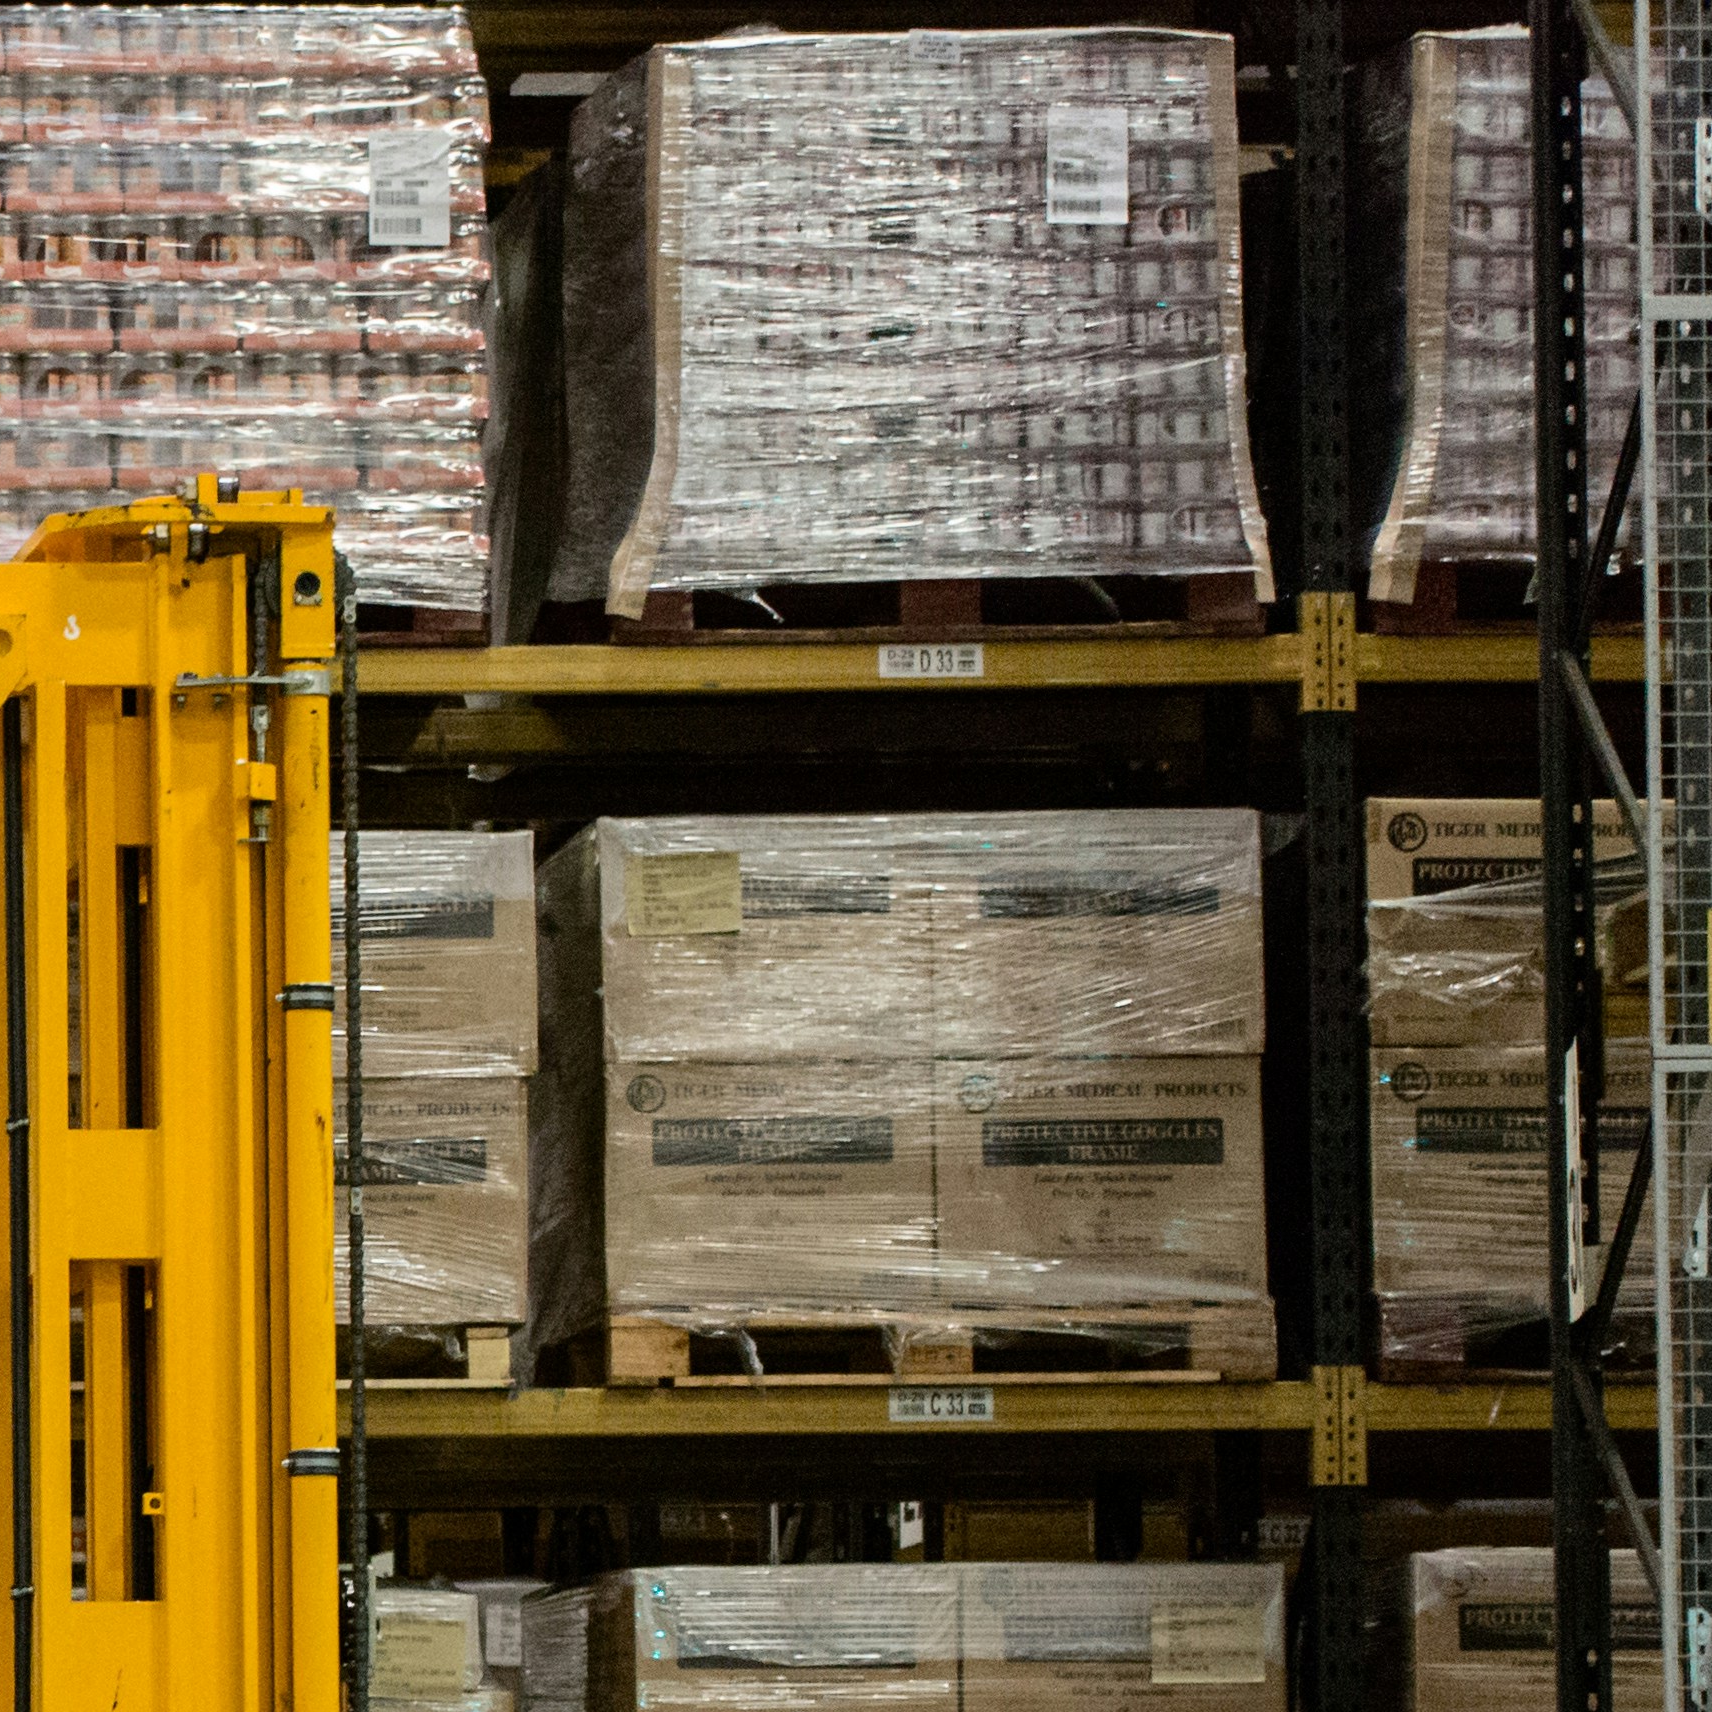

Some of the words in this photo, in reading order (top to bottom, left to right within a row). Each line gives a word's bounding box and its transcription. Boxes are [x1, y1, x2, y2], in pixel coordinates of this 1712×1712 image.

[920, 649, 931, 673] D
[936, 649, 953, 673] 33
[1495, 822, 1544, 838] MEDI
[1154, 1081, 1249, 1098] PRODUCTS
[1121, 1122, 1220, 1139] GOGGLES
[1068, 1145, 1140, 1161] FRAME
[930, 1392, 941, 1416] C
[946, 1392, 964, 1416] 33
[1466, 1608, 1555, 1627] PROTECT
